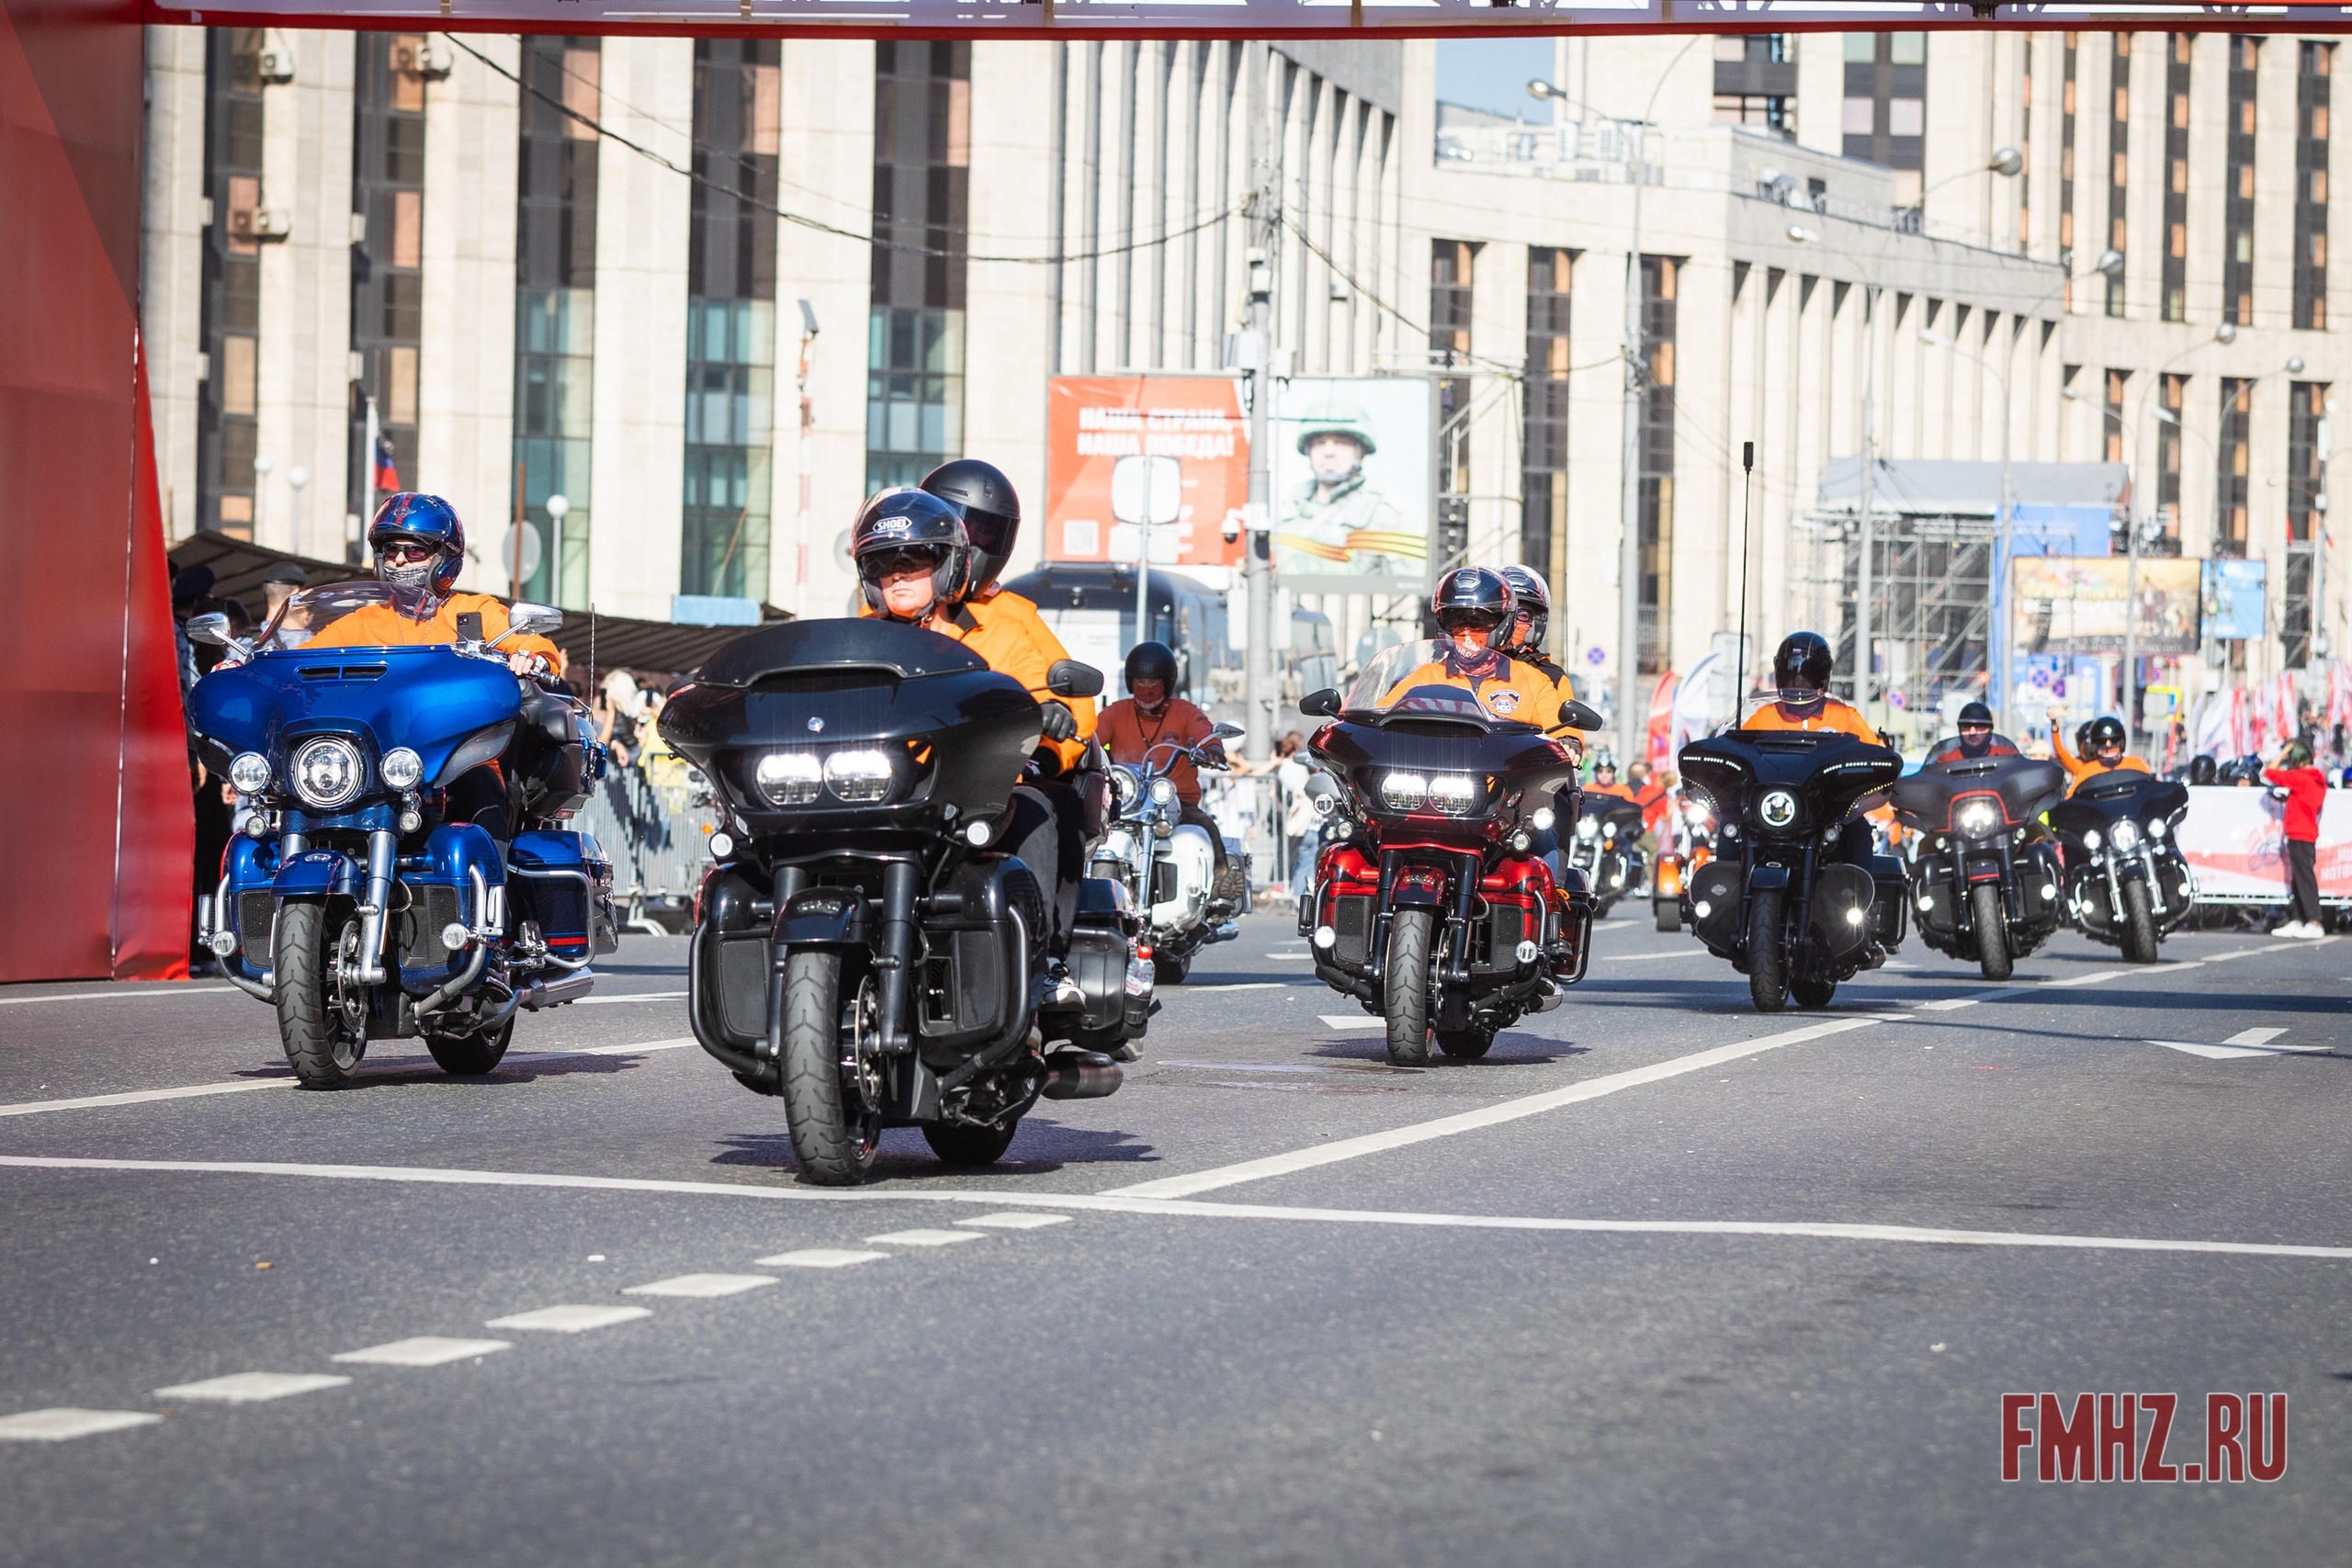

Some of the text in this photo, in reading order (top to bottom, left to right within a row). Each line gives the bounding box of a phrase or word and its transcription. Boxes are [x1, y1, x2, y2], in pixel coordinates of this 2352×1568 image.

[1079, 408, 1144, 430] НАША
[1077, 433, 1235, 459] НАША ПОБЕДА!
[876, 519, 907, 531] SHOEI
